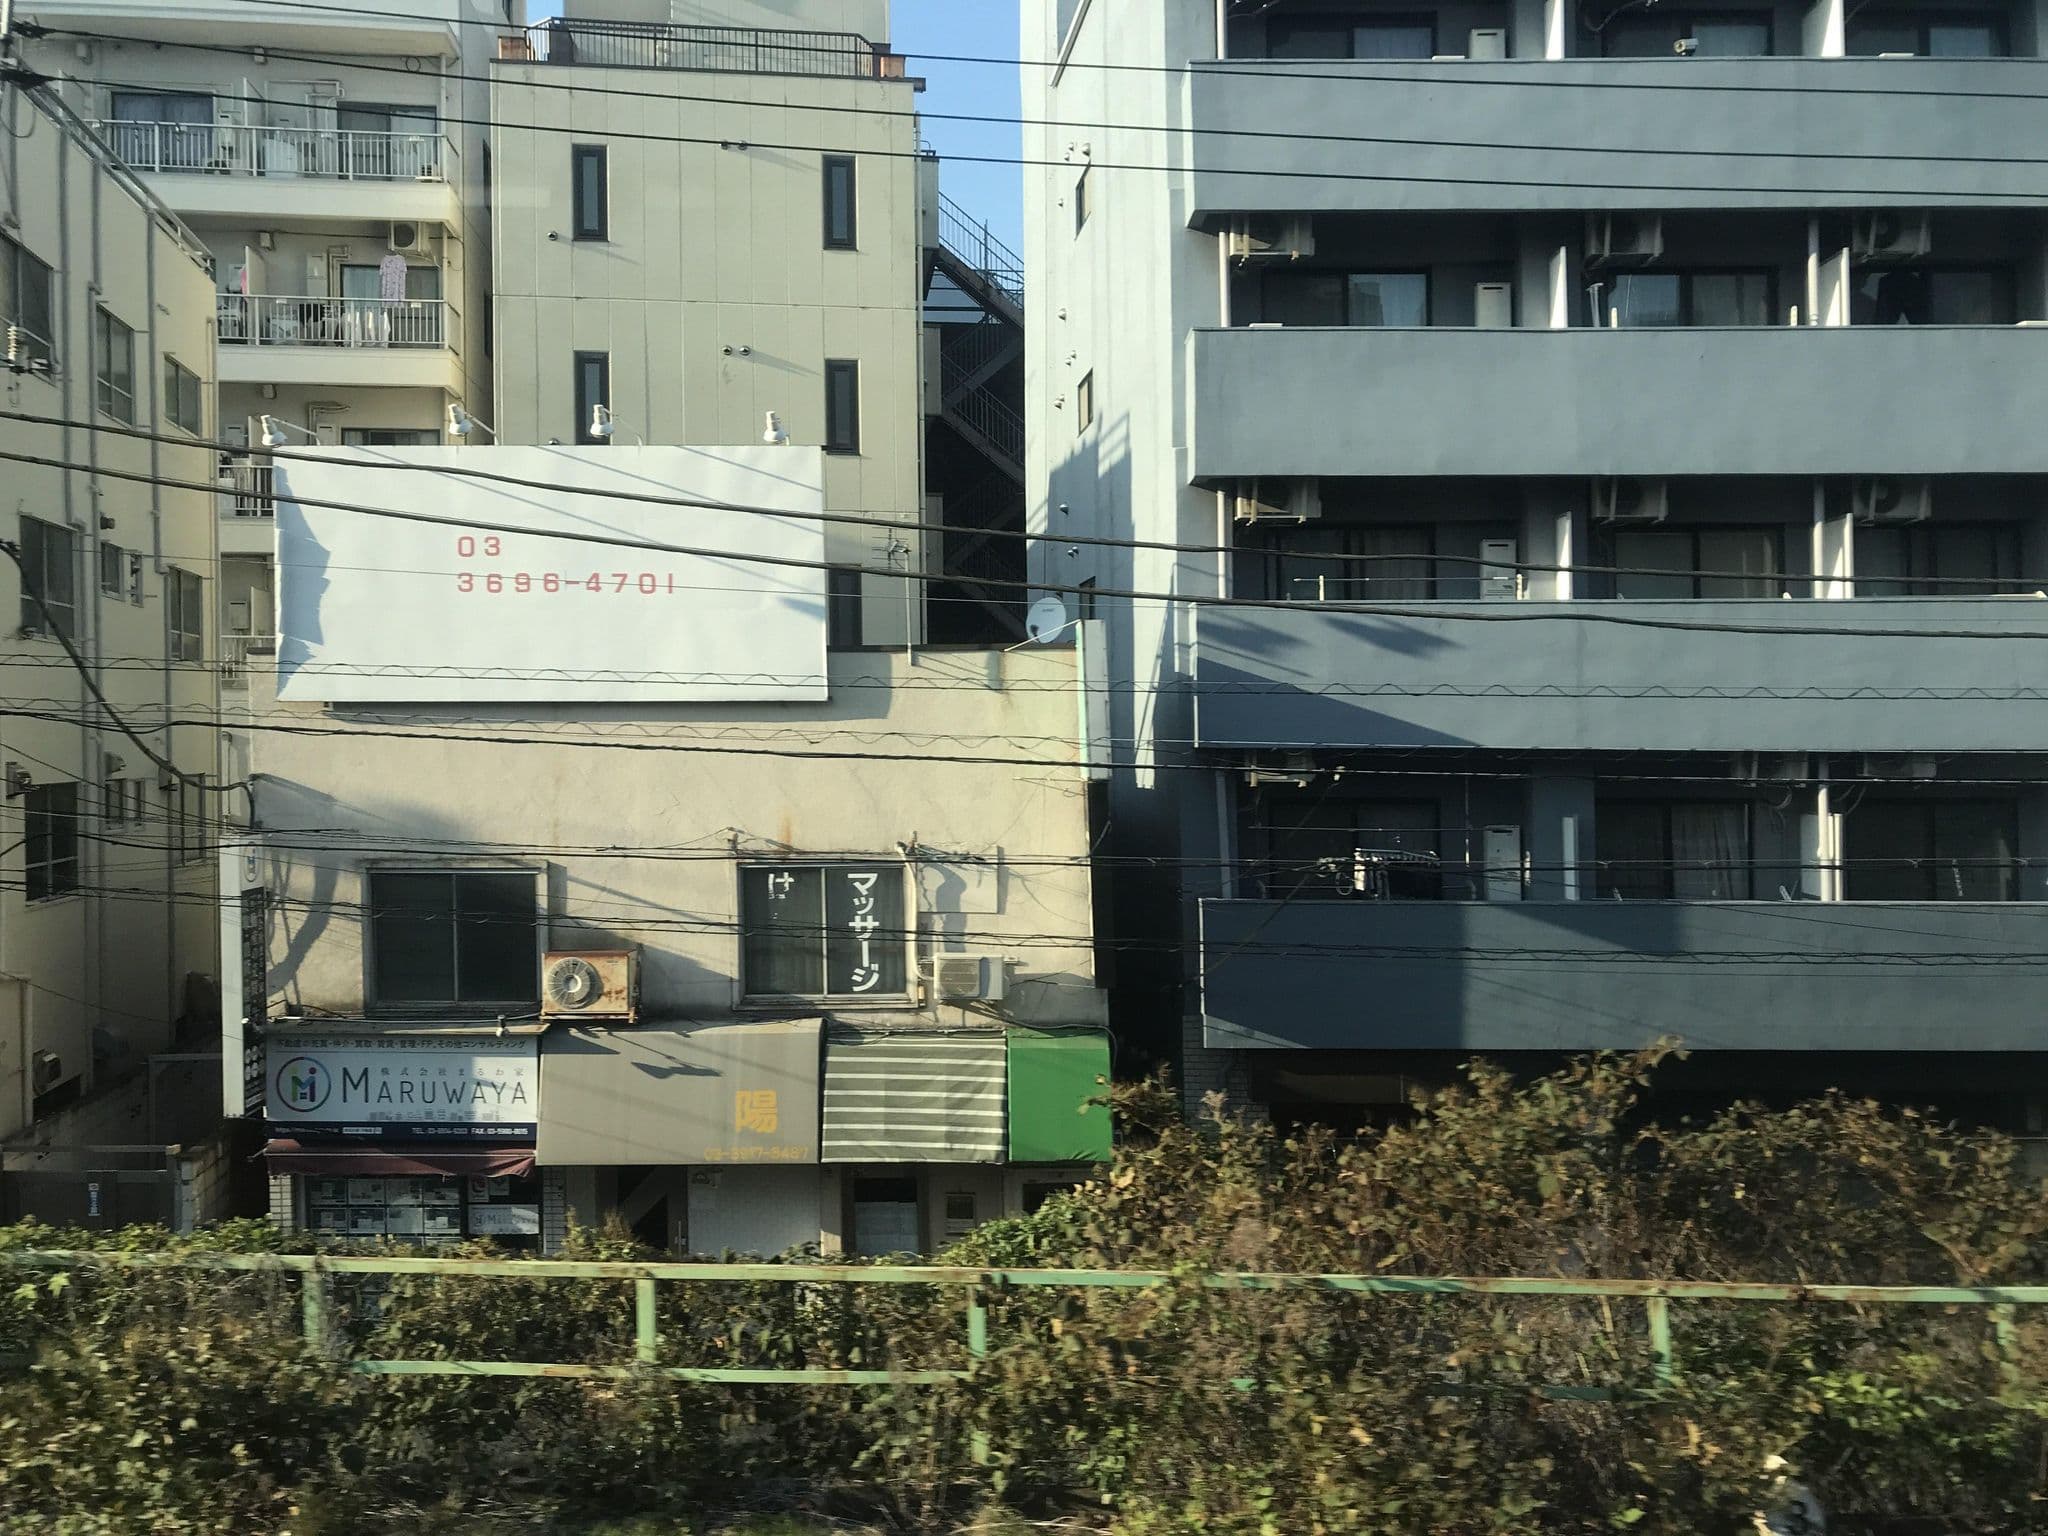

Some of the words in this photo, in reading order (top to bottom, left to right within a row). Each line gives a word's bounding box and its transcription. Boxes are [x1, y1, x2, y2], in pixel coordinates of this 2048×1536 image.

[457, 536, 501, 558] 03
[457, 572, 673, 594] 3696-4701
[847, 873, 880, 992] マッサージ
[342, 1066, 527, 1104] MARUWAYA
